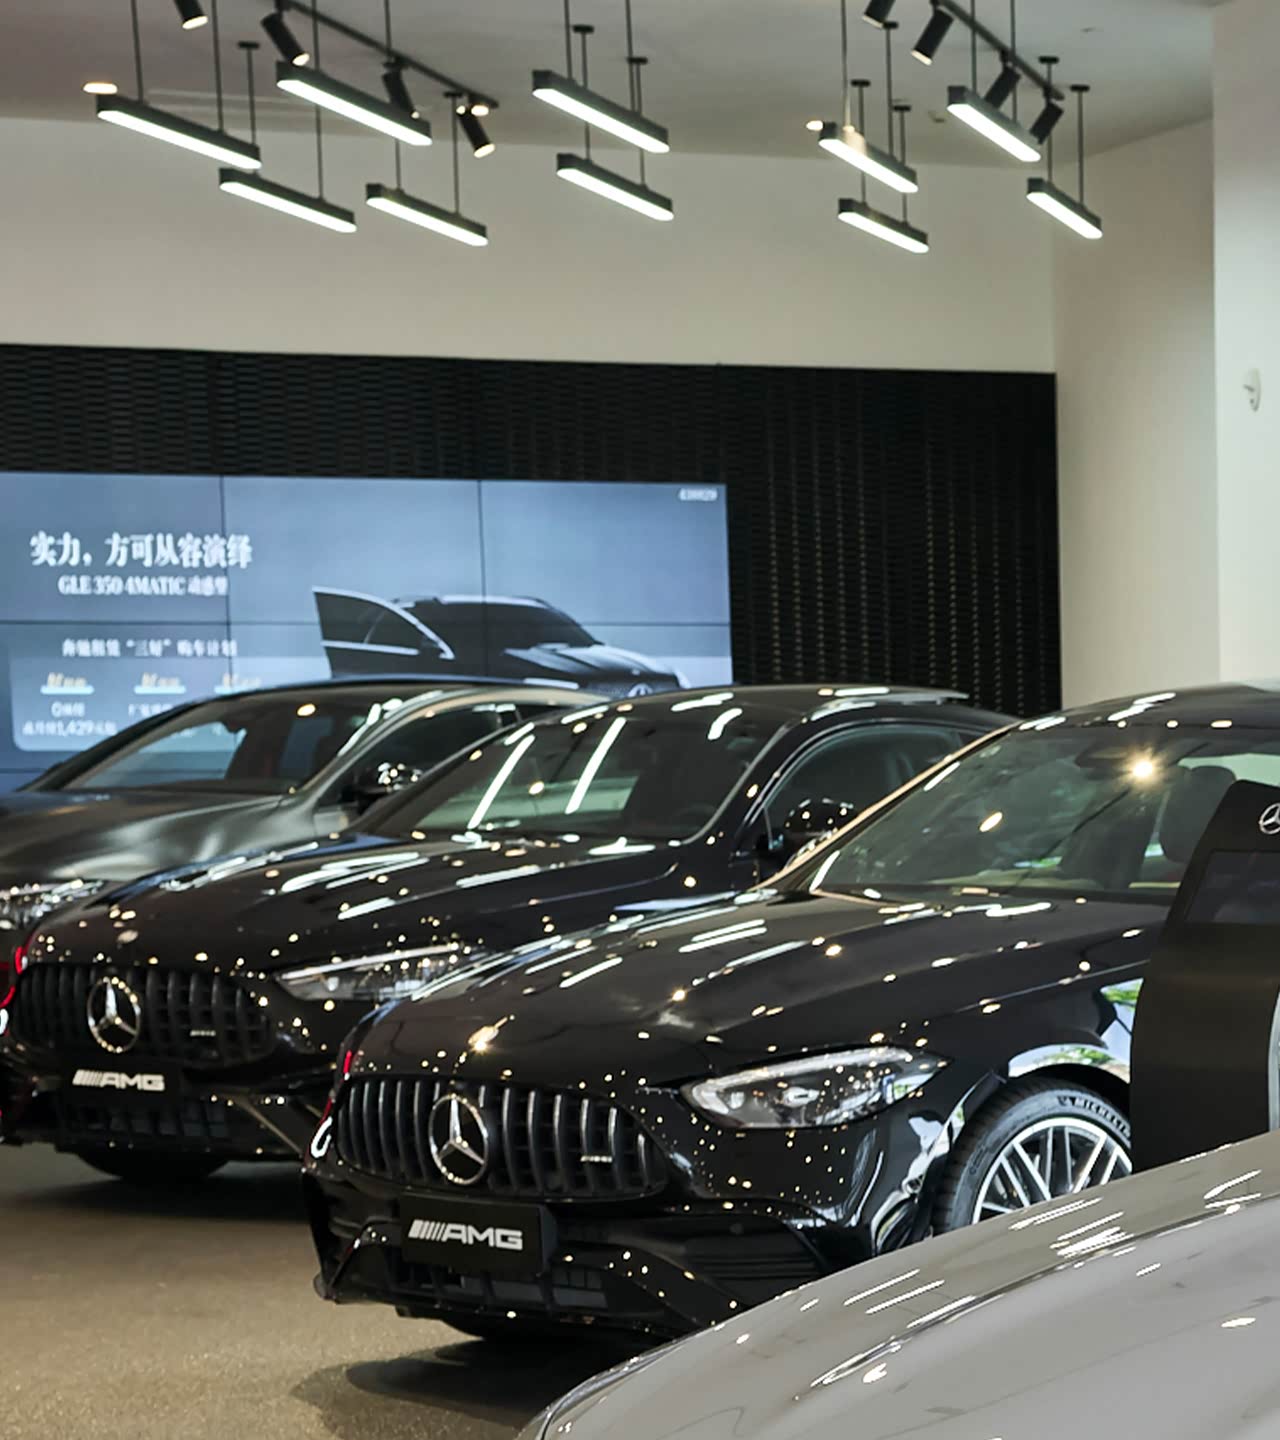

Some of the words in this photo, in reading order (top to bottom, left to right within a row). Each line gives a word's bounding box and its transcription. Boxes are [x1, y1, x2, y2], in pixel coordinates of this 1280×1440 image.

[57, 574, 92, 595] GLE
[93, 574, 124, 595] 350
[125, 574, 186, 596] 4MATIC
[100, 1070, 166, 1091] AMG
[442, 1222, 523, 1250] AMG
